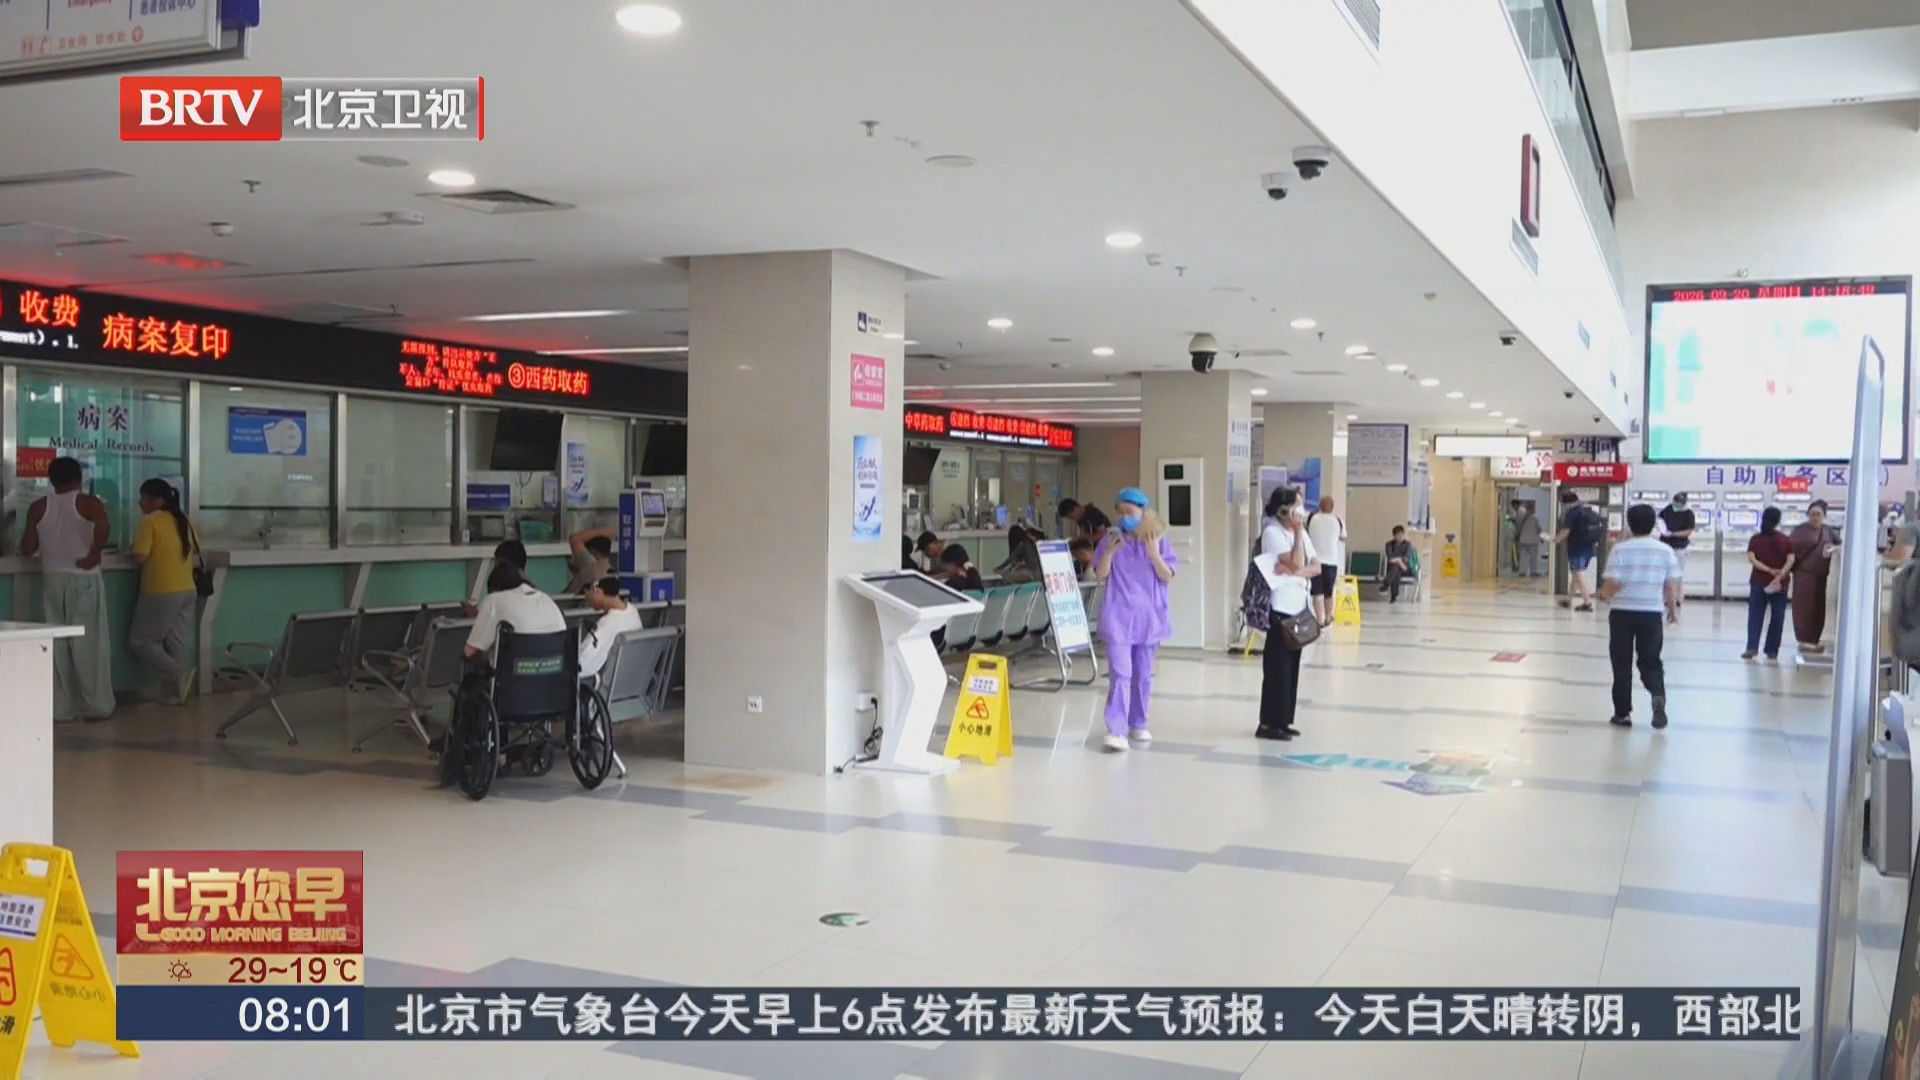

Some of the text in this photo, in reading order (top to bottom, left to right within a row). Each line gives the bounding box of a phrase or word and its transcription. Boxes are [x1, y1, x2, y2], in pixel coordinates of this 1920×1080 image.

[19, 289, 80, 328] 收费
[102, 311, 231, 361] 病案复印
[77, 404, 130, 432] 病案
[50, 437, 154, 453] Medical Records
[1564, 438, 1615, 453] 卫生间
[958, 721, 993, 737] 小心地滑
